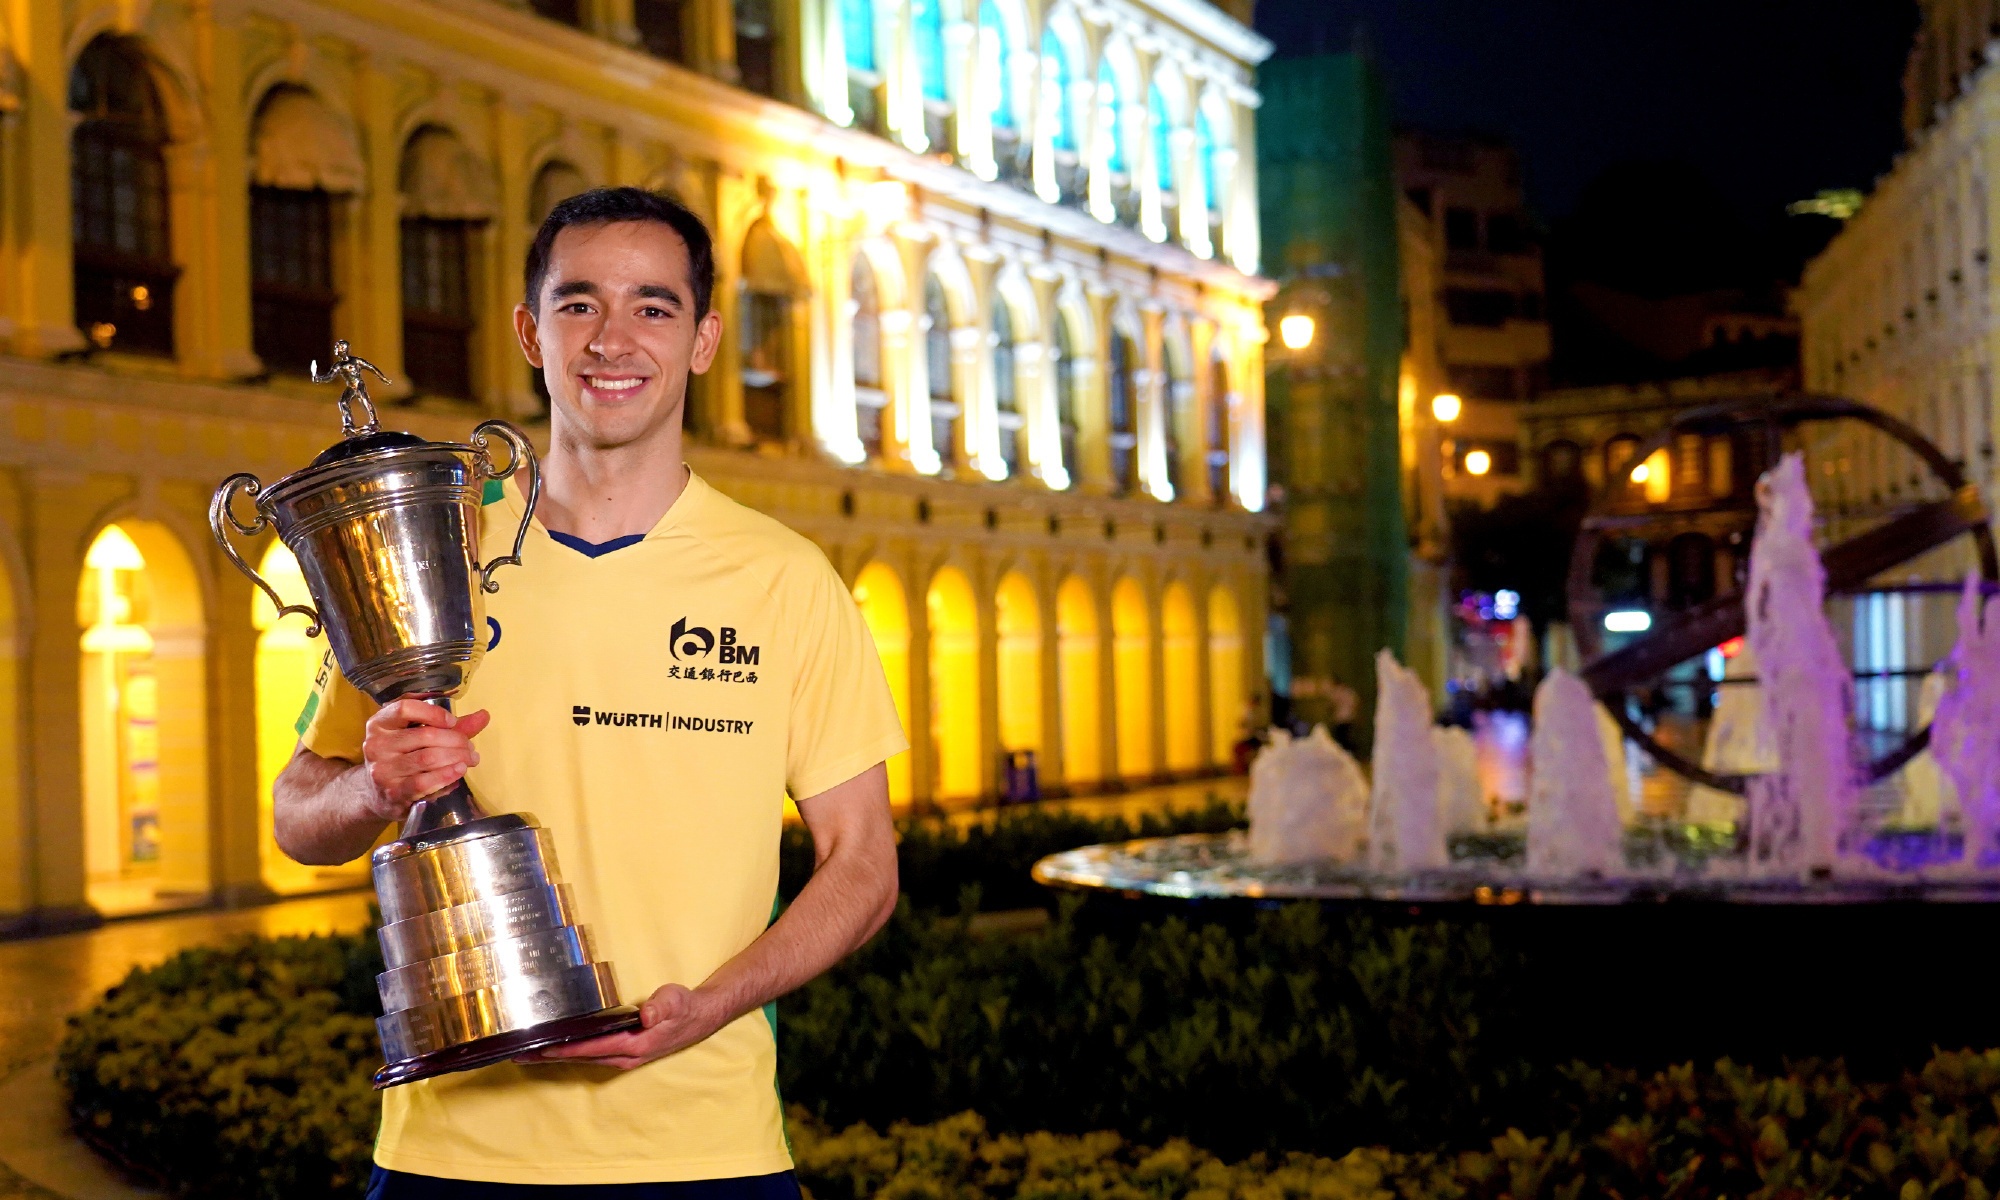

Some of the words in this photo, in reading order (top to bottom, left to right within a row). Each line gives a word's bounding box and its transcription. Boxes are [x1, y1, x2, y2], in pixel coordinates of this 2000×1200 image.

[720, 627, 736, 646] B
[719, 645, 760, 666] BM
[666, 665, 759, 685] 交通銀行巴西
[594, 711, 663, 729] WÜRTH
[672, 715, 754, 735] INDUSTRY
